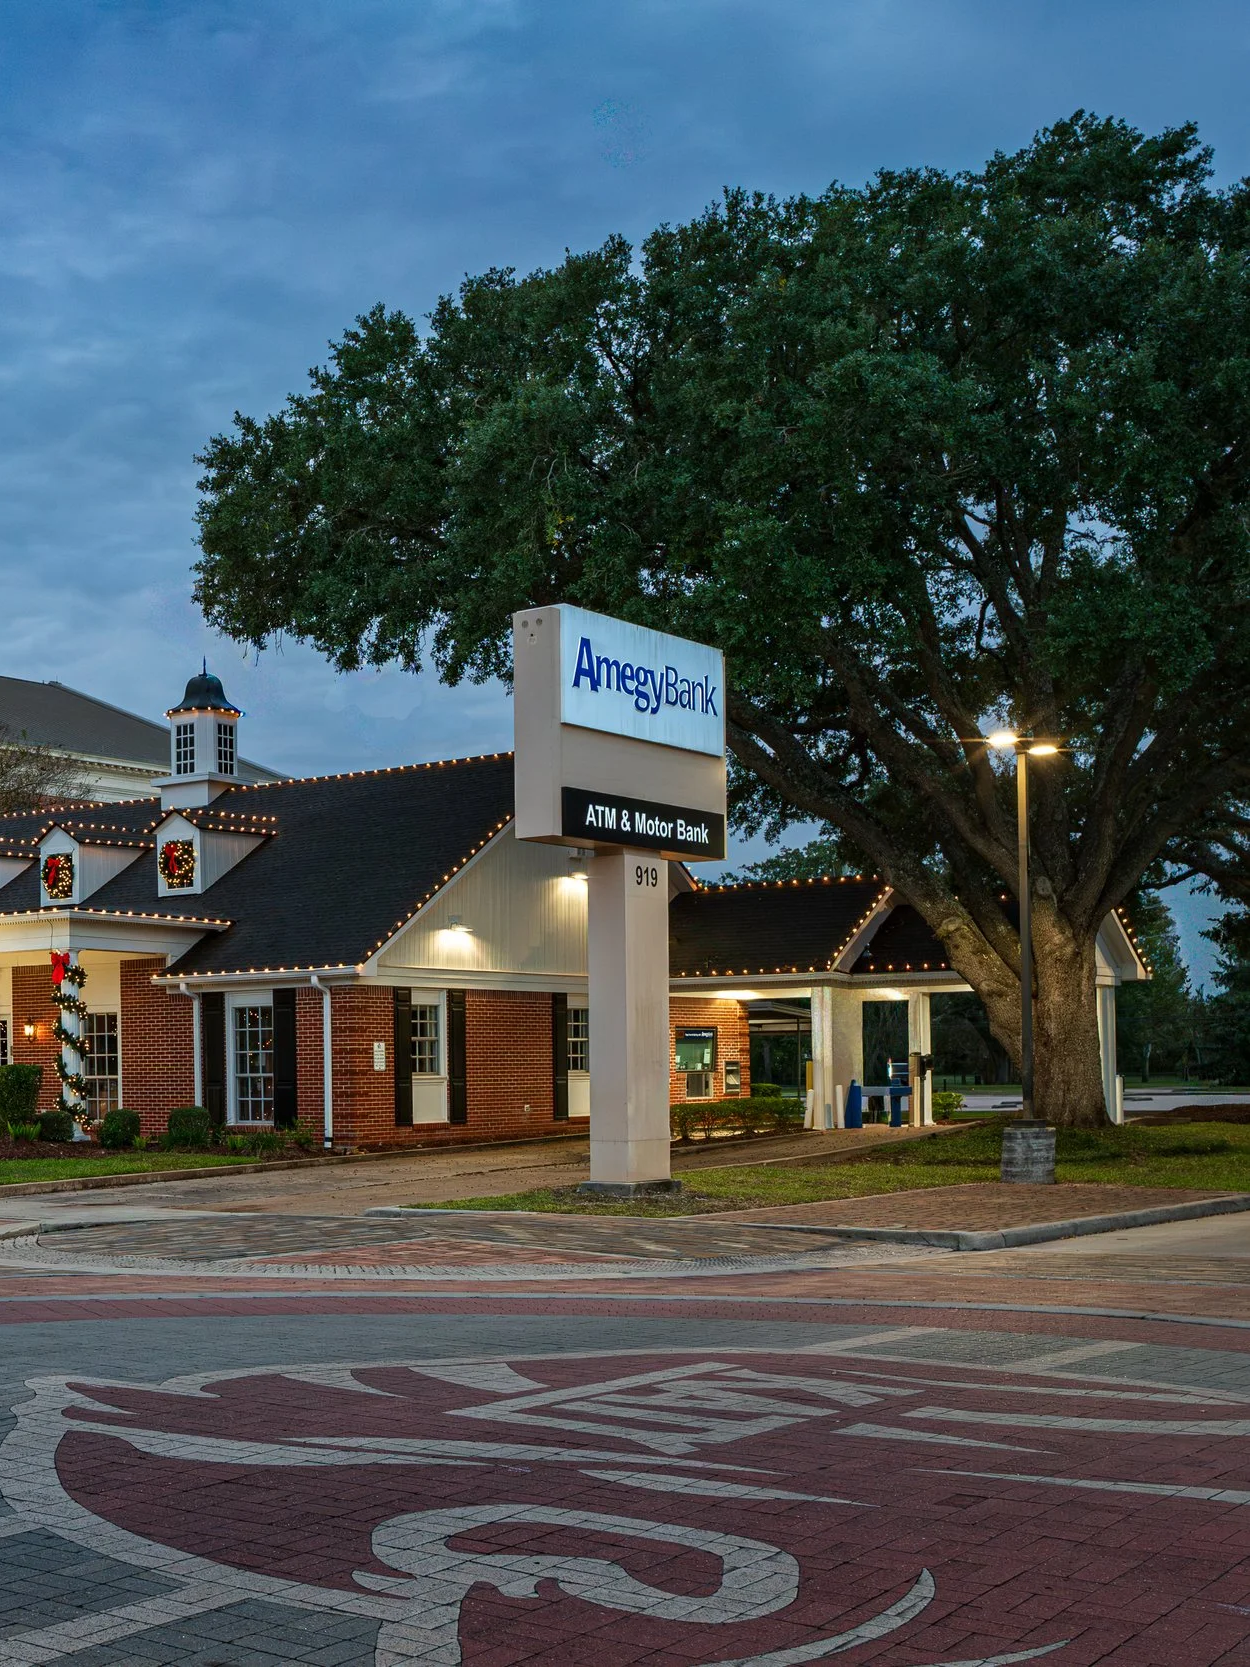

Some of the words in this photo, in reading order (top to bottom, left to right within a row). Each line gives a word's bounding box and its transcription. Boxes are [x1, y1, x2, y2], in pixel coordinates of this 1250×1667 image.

[572, 637, 718, 716] AmegyBank
[585, 804, 617, 830] ATM
[620, 809, 631, 832] &
[635, 812, 674, 838] Motor
[676, 819, 709, 844] Bank
[635, 865, 658, 888] 919
